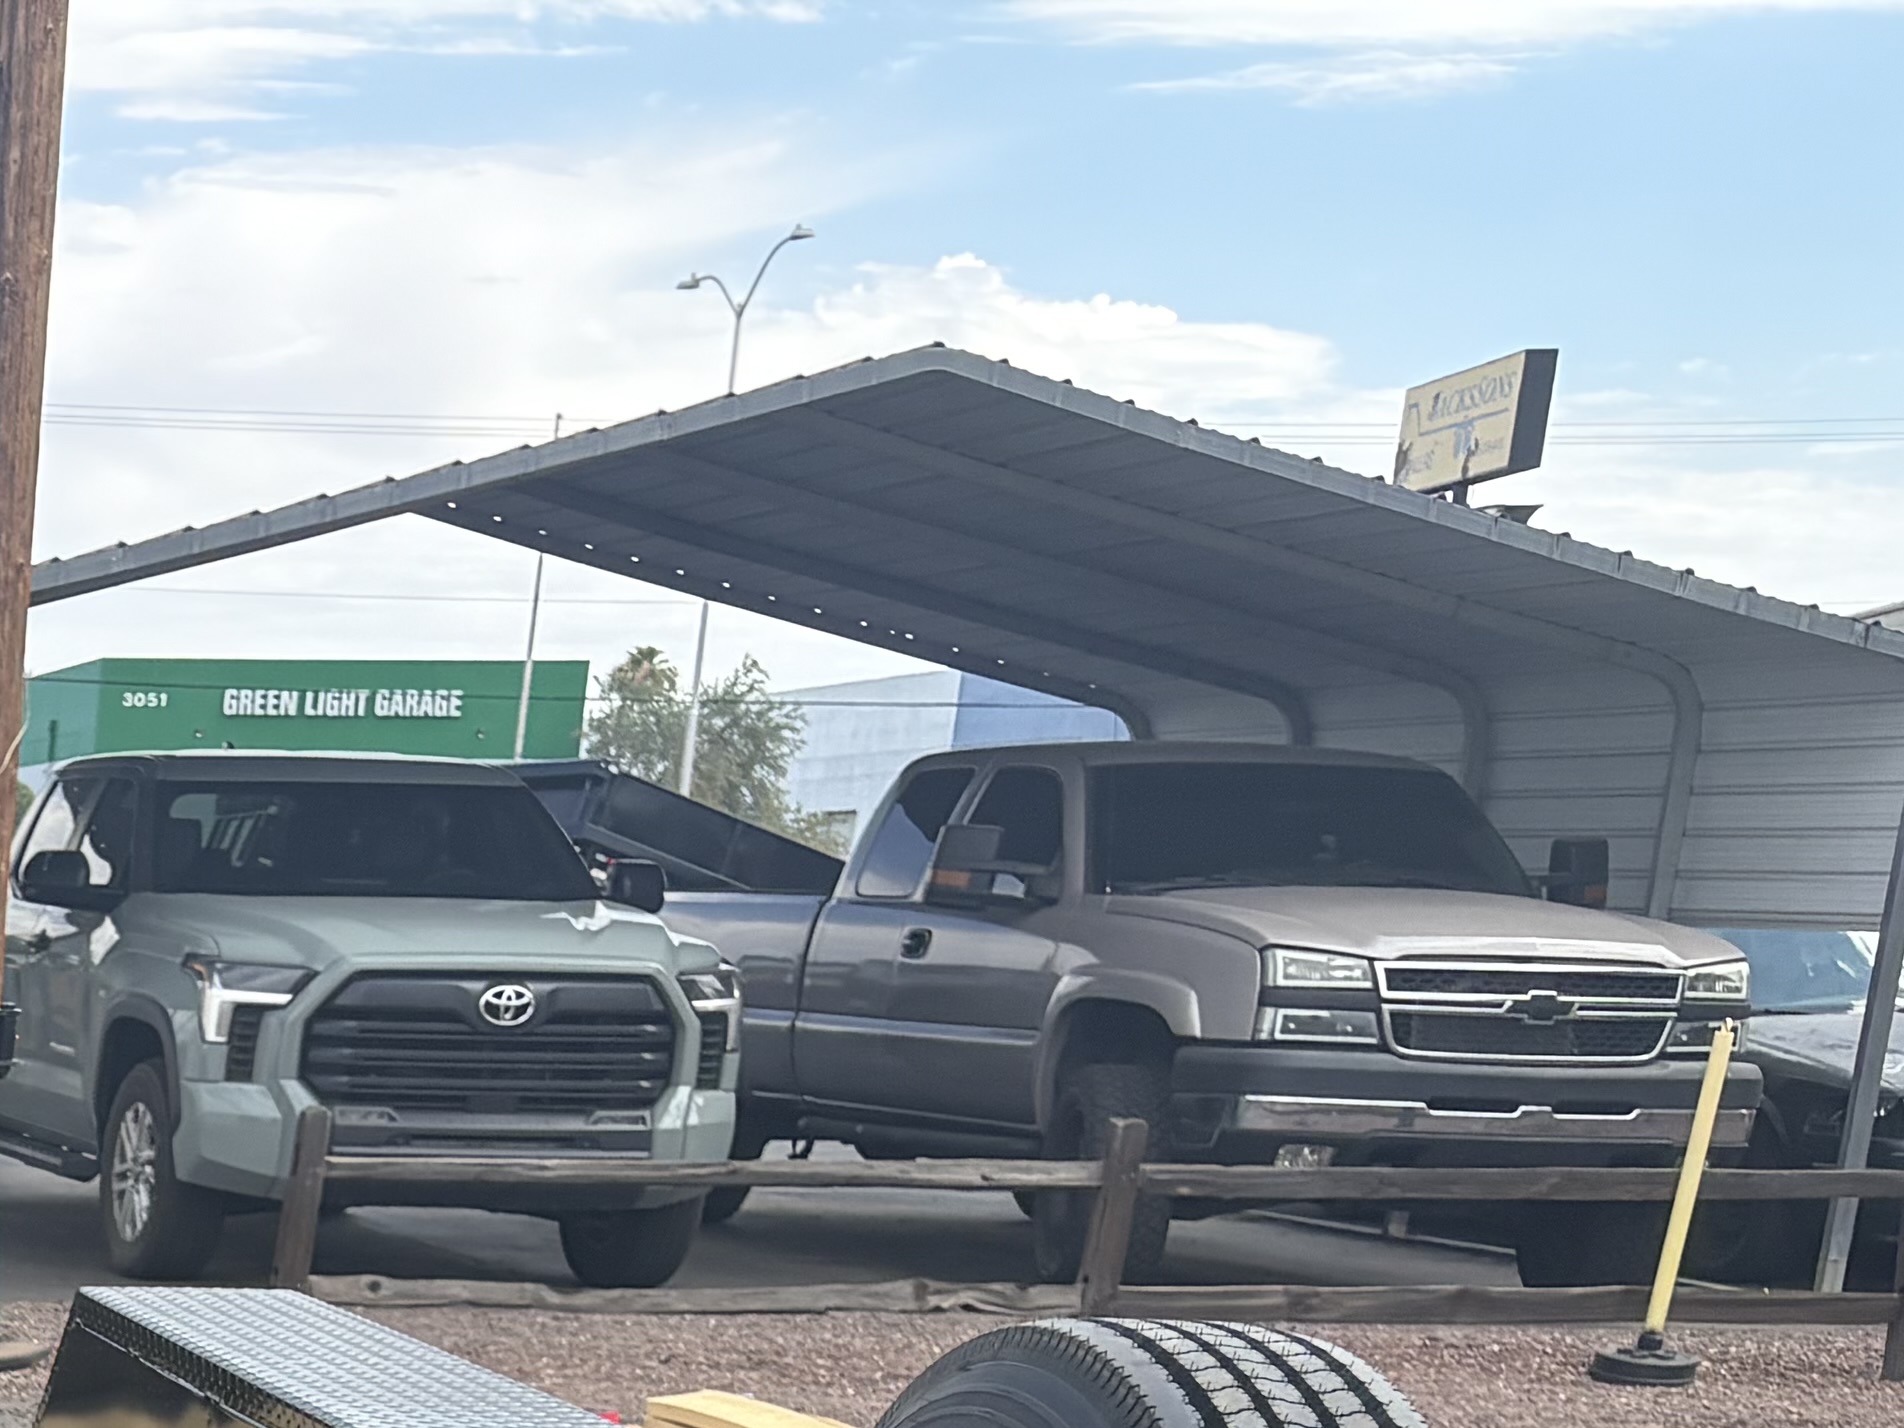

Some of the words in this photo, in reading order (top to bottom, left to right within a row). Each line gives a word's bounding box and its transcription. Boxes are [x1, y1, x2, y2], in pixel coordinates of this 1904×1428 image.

[121, 692, 168, 707] 3051
[223, 688, 299, 716] GREEN
[304, 689, 370, 717] LIGHT
[373, 689, 464, 718] GARAGE
